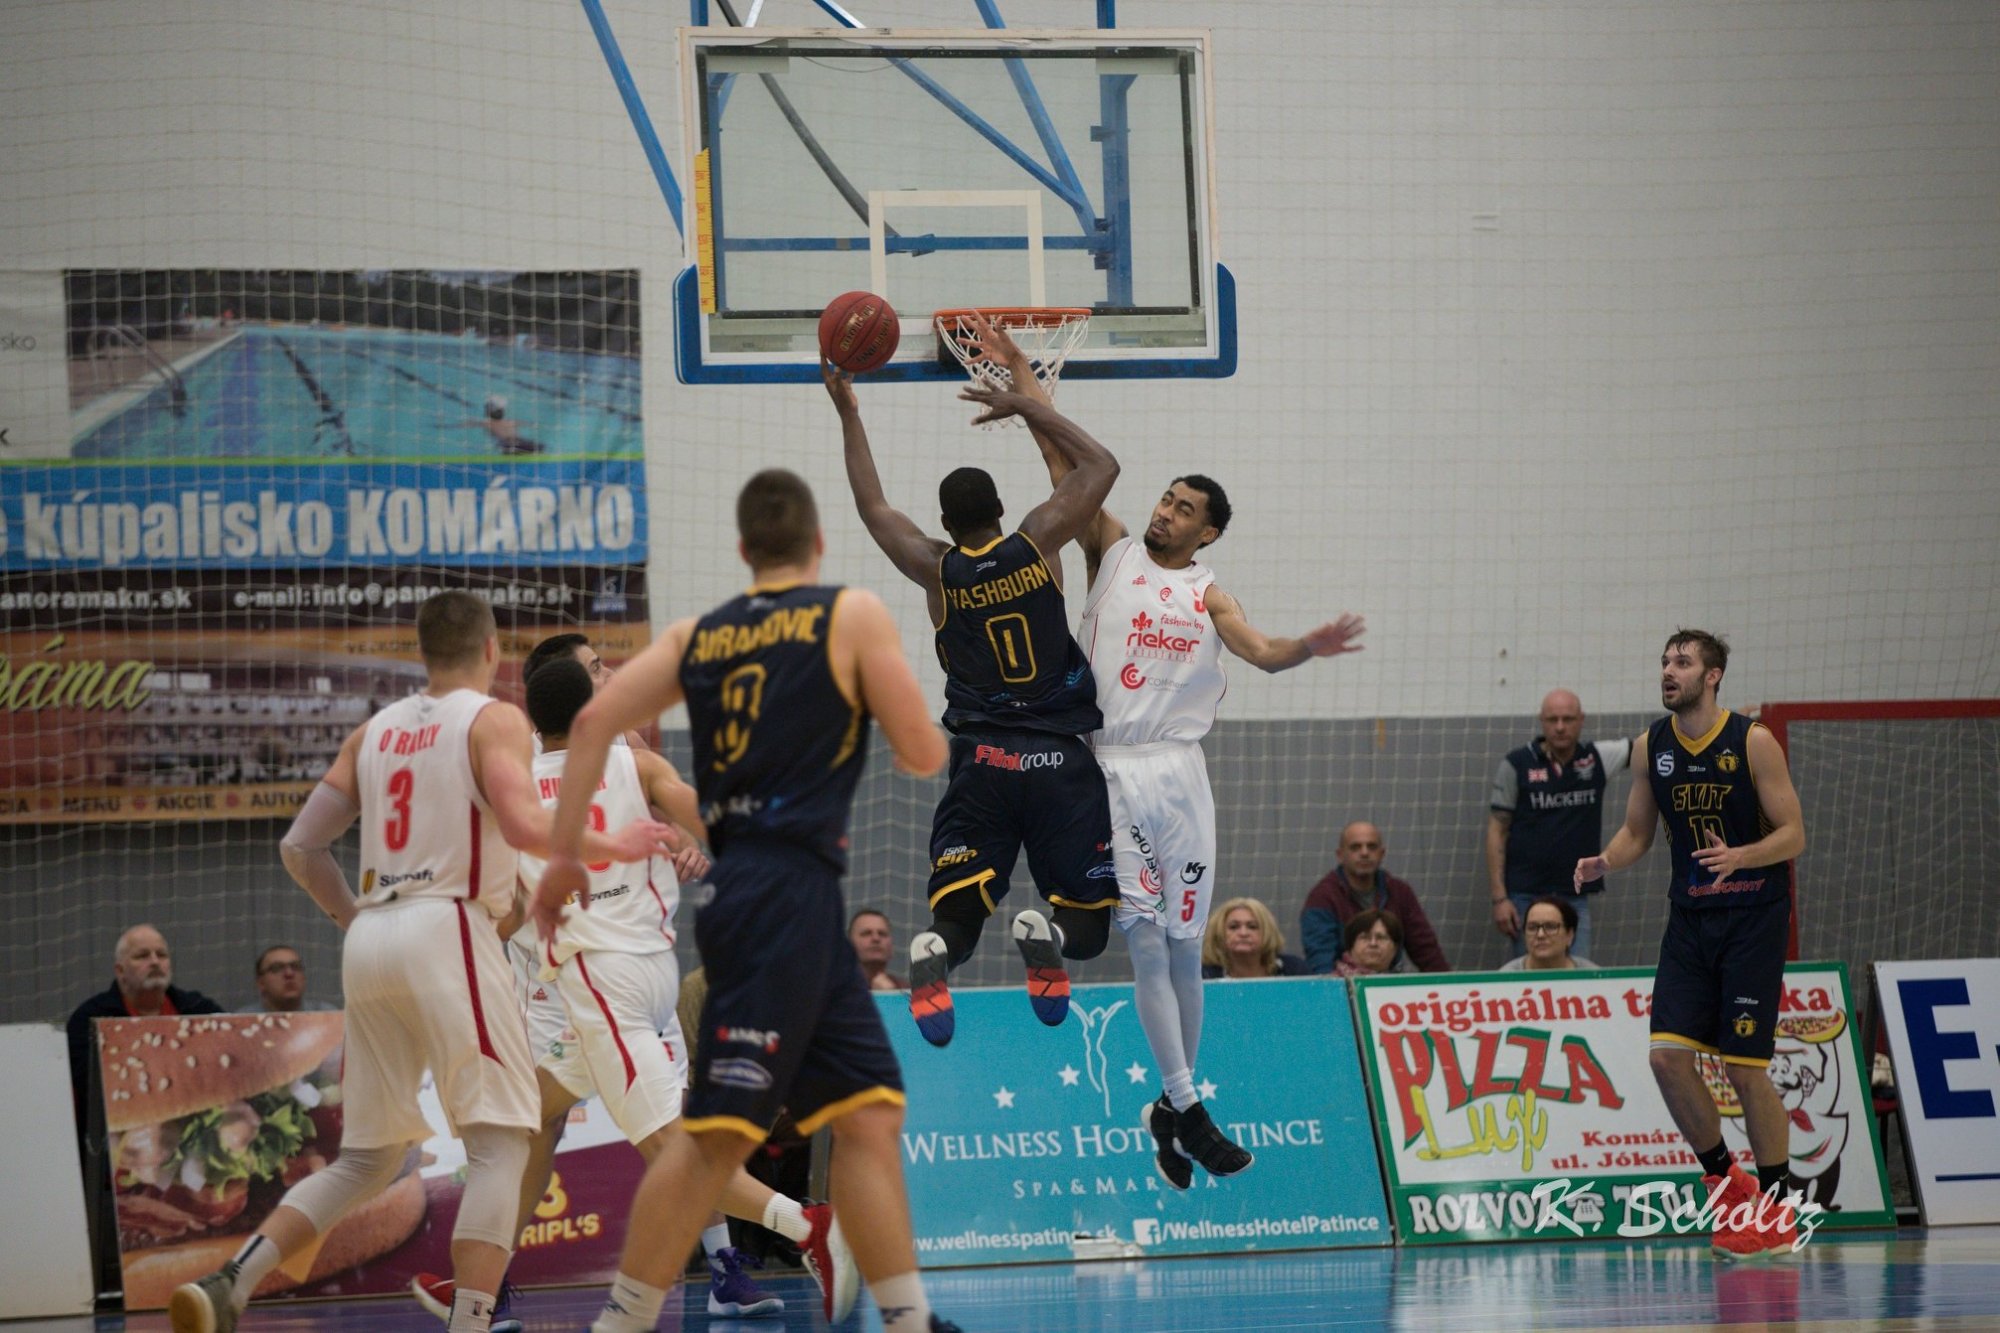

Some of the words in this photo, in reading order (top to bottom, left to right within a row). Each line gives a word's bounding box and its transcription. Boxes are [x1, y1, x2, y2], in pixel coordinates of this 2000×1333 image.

[24, 490, 333, 566] kúpalisko
[349, 475, 635, 556] KOMÁRNO
[985, 613, 1038, 683] 0
[1127, 629, 1200, 653] rieker
[384, 767, 414, 853] 3
[1529, 789, 1596, 809] HACKETT
[1672, 783, 1733, 811] SVIT
[1181, 890, 1197, 922] 5
[1379, 989, 1612, 1032] originálna
[1379, 1026, 1625, 1150] PIZZA
[902, 1130, 1062, 1165] WELLNESS
[1072, 1125, 1158, 1158] HOT
[1219, 1119, 1325, 1148] TINCE
[1410, 1085, 1548, 1172] Lux
[1552, 1153, 1588, 1170] ul.
[1597, 1150, 1698, 1168] Jókaih
